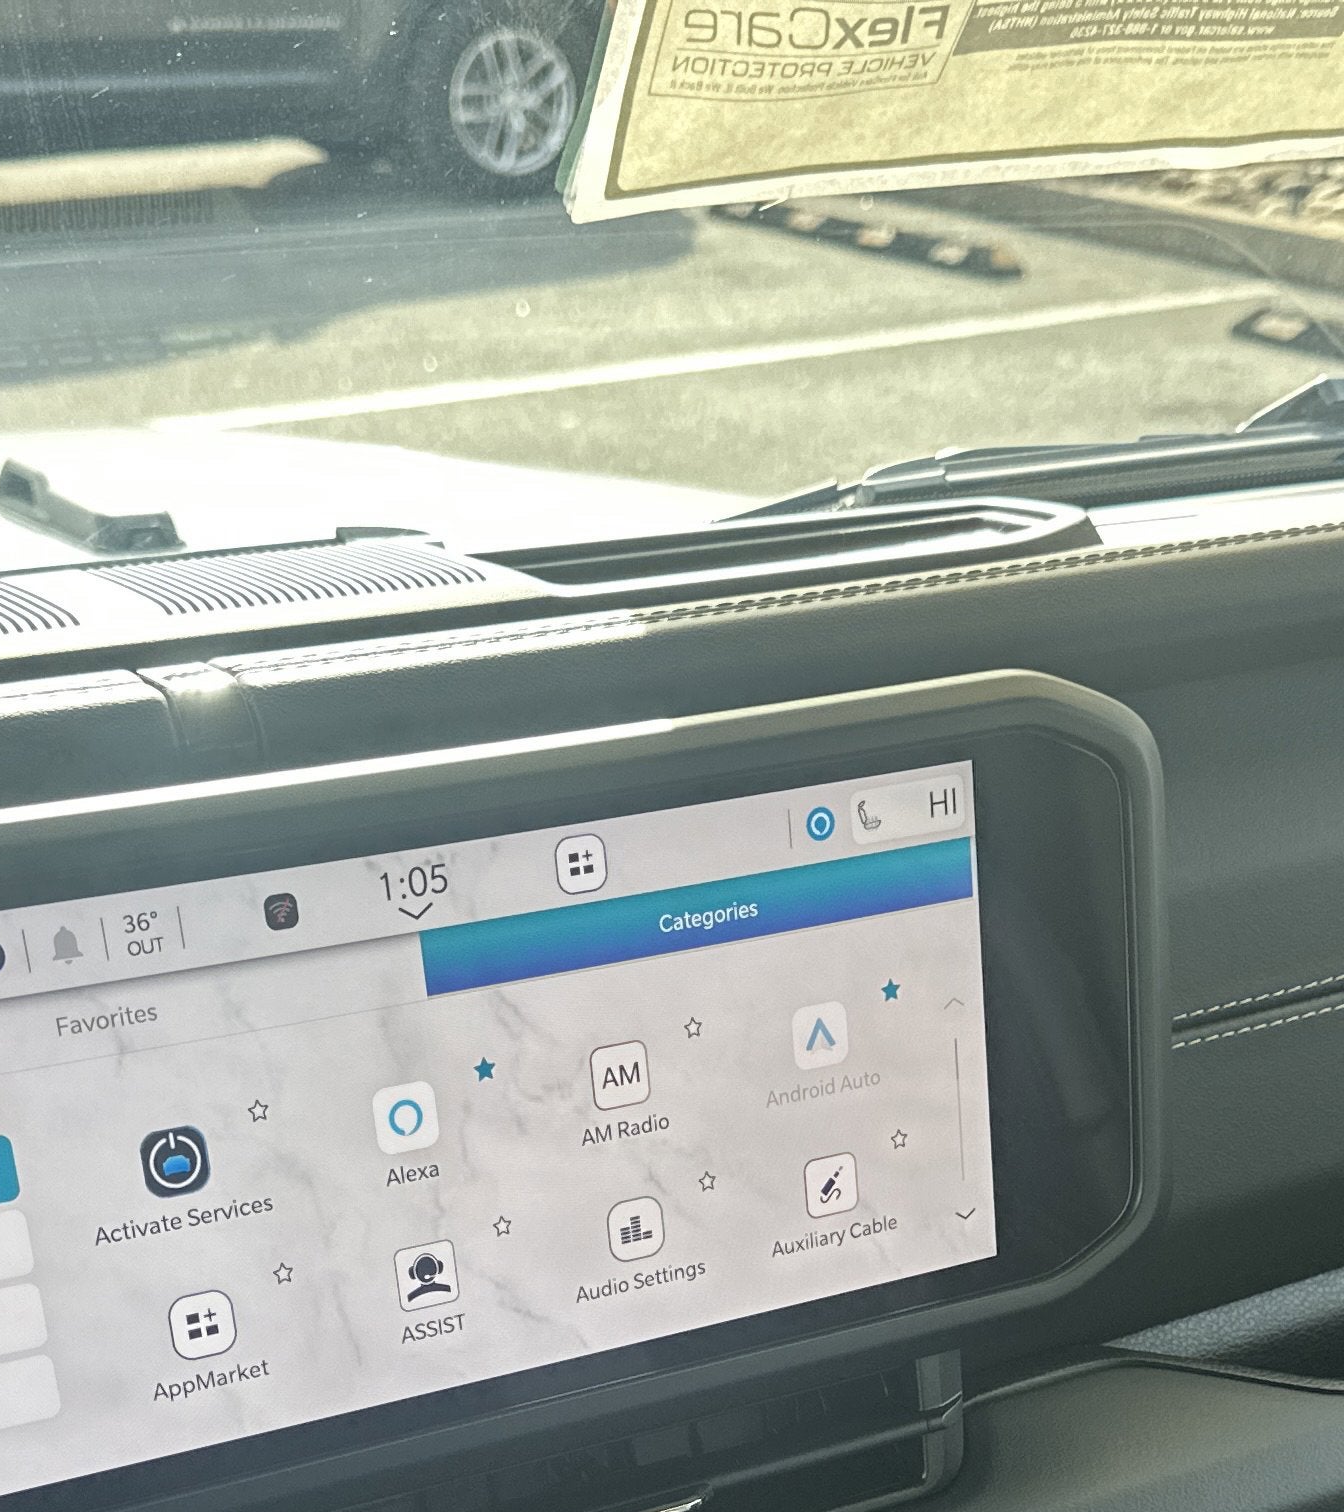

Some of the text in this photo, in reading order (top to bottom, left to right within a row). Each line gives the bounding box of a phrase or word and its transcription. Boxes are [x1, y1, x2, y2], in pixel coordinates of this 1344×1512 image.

[929, 787, 959, 820] HI
[379, 863, 449, 902] 1:05
[122, 911, 159, 935] 36°
[658, 900, 759, 936] Categories
[126, 937, 164, 958] OUT
[56, 1003, 158, 1038] Favorites
[601, 1061, 642, 1089] AM
[765, 1067, 882, 1109] Android Auto
[580, 1111, 671, 1146] AM Radio
[385, 1160, 441, 1187] Alexa
[94, 1194, 274, 1247] Activate Services
[771, 1215, 899, 1258] Auxiliary Cable
[575, 1259, 707, 1303] Audio Settings
[400, 1312, 466, 1344] ASSIST
[152, 1358, 270, 1403] AppMarket
